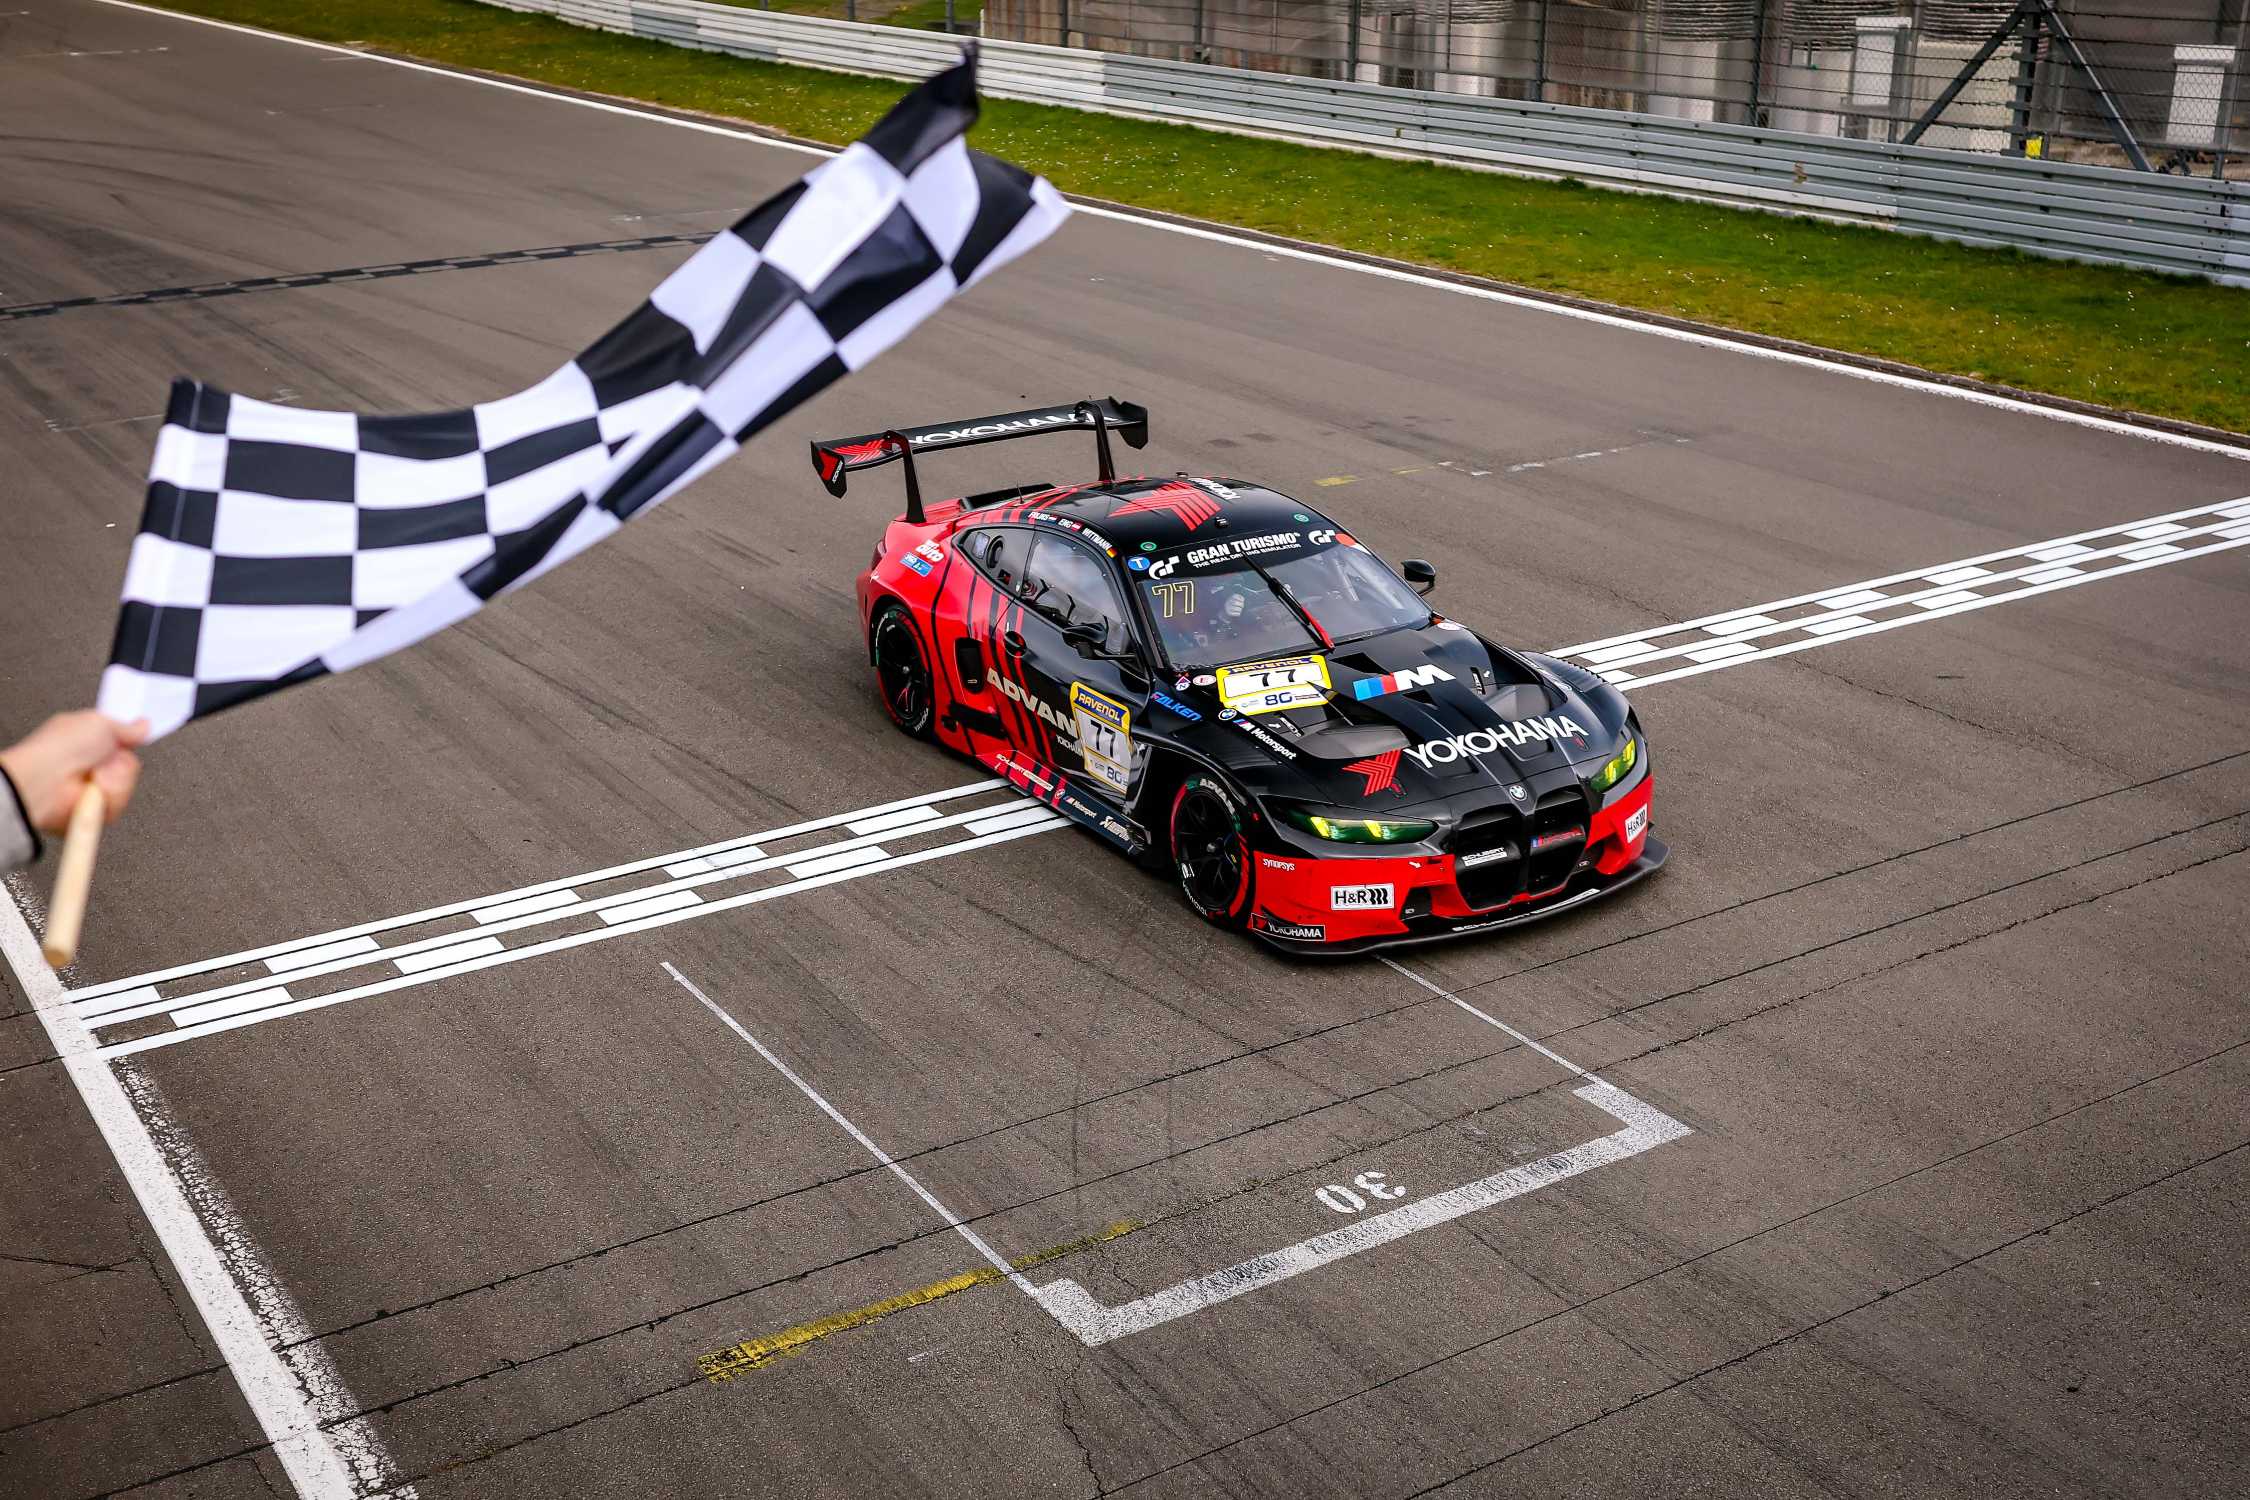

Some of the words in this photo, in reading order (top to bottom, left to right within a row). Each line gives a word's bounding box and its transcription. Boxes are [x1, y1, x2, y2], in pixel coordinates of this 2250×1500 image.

[1187, 543, 1231, 564] GRAN
[1231, 532, 1298, 556] TURISMO
[1193, 561, 1210, 569] THE
[1211, 555, 1230, 564] REAL
[1260, 543, 1302, 555] SIMULATOR
[1152, 580, 1194, 618] 77
[1233, 658, 1309, 673] RAVENOL
[1250, 668, 1296, 687] 77
[987, 667, 1080, 739] ADVAN
[1078, 693, 1120, 721] RAVENOL
[1090, 719, 1116, 758] 77
[1251, 728, 1297, 760] Motorsport
[1403, 715, 1590, 769] YOKOHAMA
[1334, 889, 1367, 905] H&R
[1315, 1171, 1407, 1214] 30
